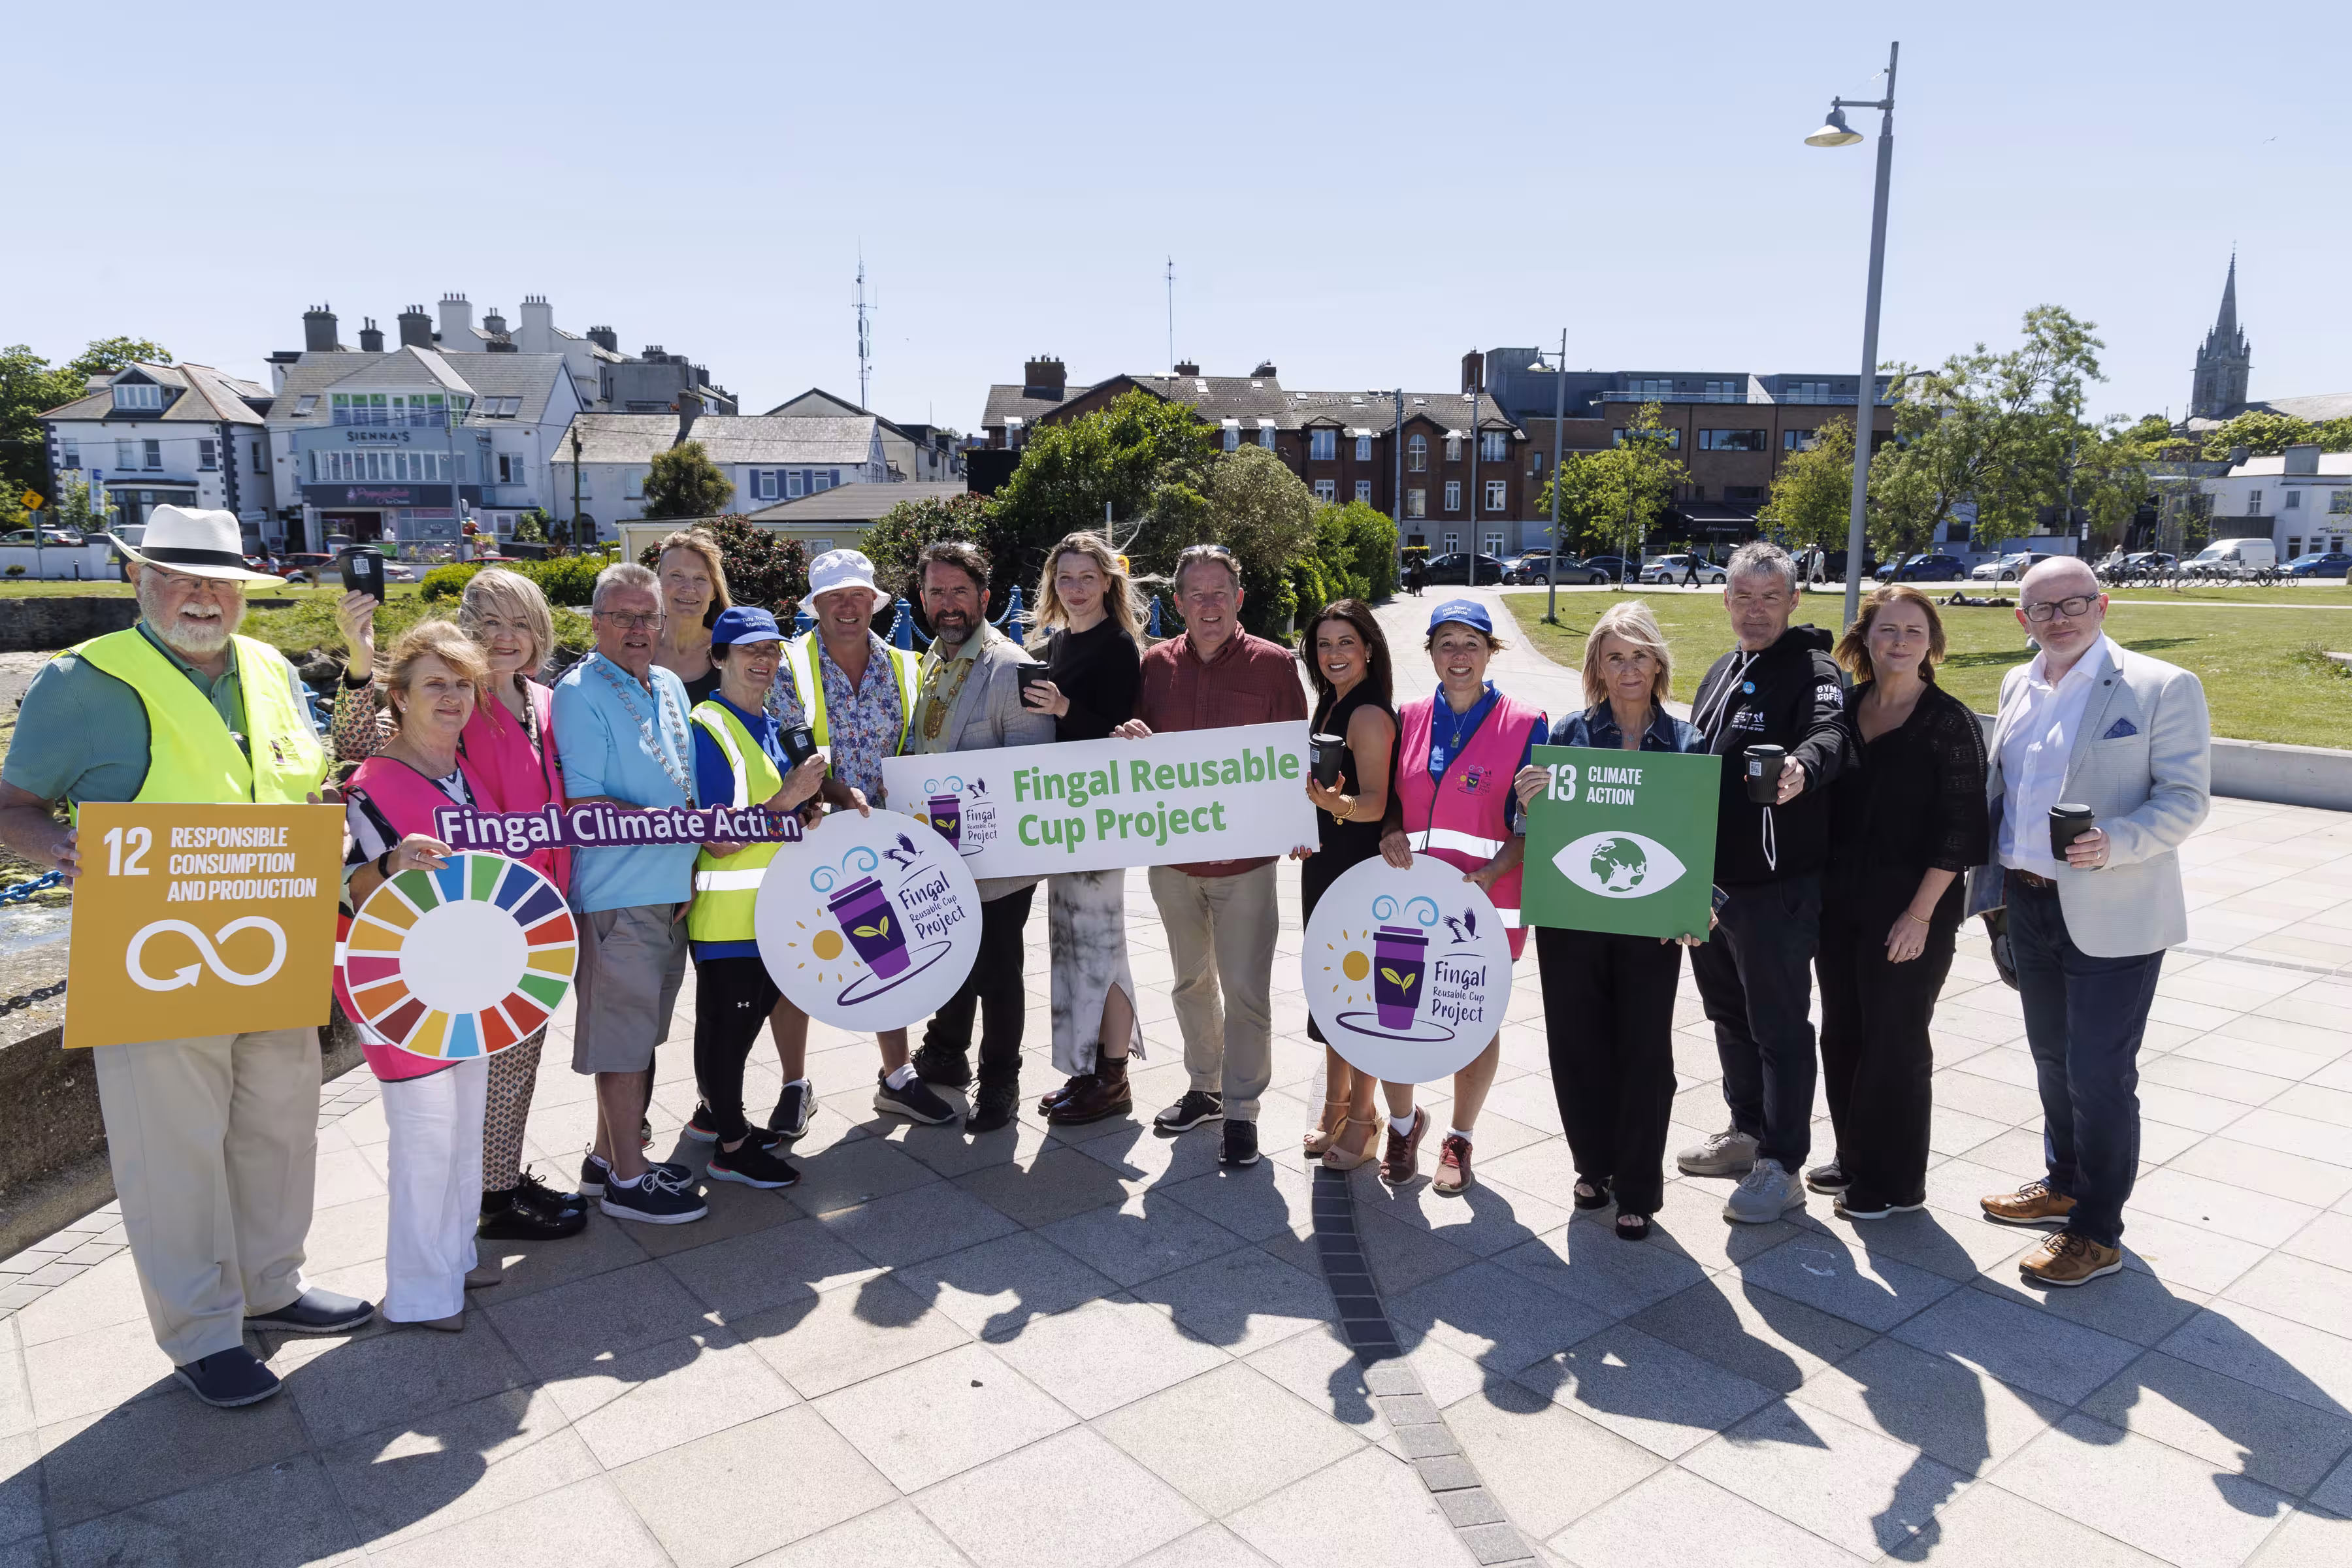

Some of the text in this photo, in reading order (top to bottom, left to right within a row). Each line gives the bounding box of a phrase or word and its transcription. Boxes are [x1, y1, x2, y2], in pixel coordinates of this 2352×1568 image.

[347, 431, 410, 442] SIENNA'S
[1013, 746, 1299, 808] Fingal Reusable
[1547, 764, 1577, 802] 13
[1588, 766, 1642, 785] CLIMATE
[1586, 787, 1635, 806] ACTION
[966, 807, 995, 823] Fingal
[1018, 800, 1226, 853] Cup Project
[171, 827, 288, 848] RESPONSIBLE
[441, 808, 799, 852] Fingal Climate Action
[968, 830, 998, 843] Project
[104, 826, 152, 875] 12
[169, 853, 295, 875] CONSUMPTION
[167, 878, 317, 902] AND PRODUCTION
[898, 871, 951, 910] Fingal
[909, 895, 956, 923] Reusable Cup
[915, 906, 966, 940] Project
[1435, 961, 1486, 990] Fingal
[1433, 987, 1484, 1004] Reusable Cup
[1432, 999, 1484, 1026] Project
